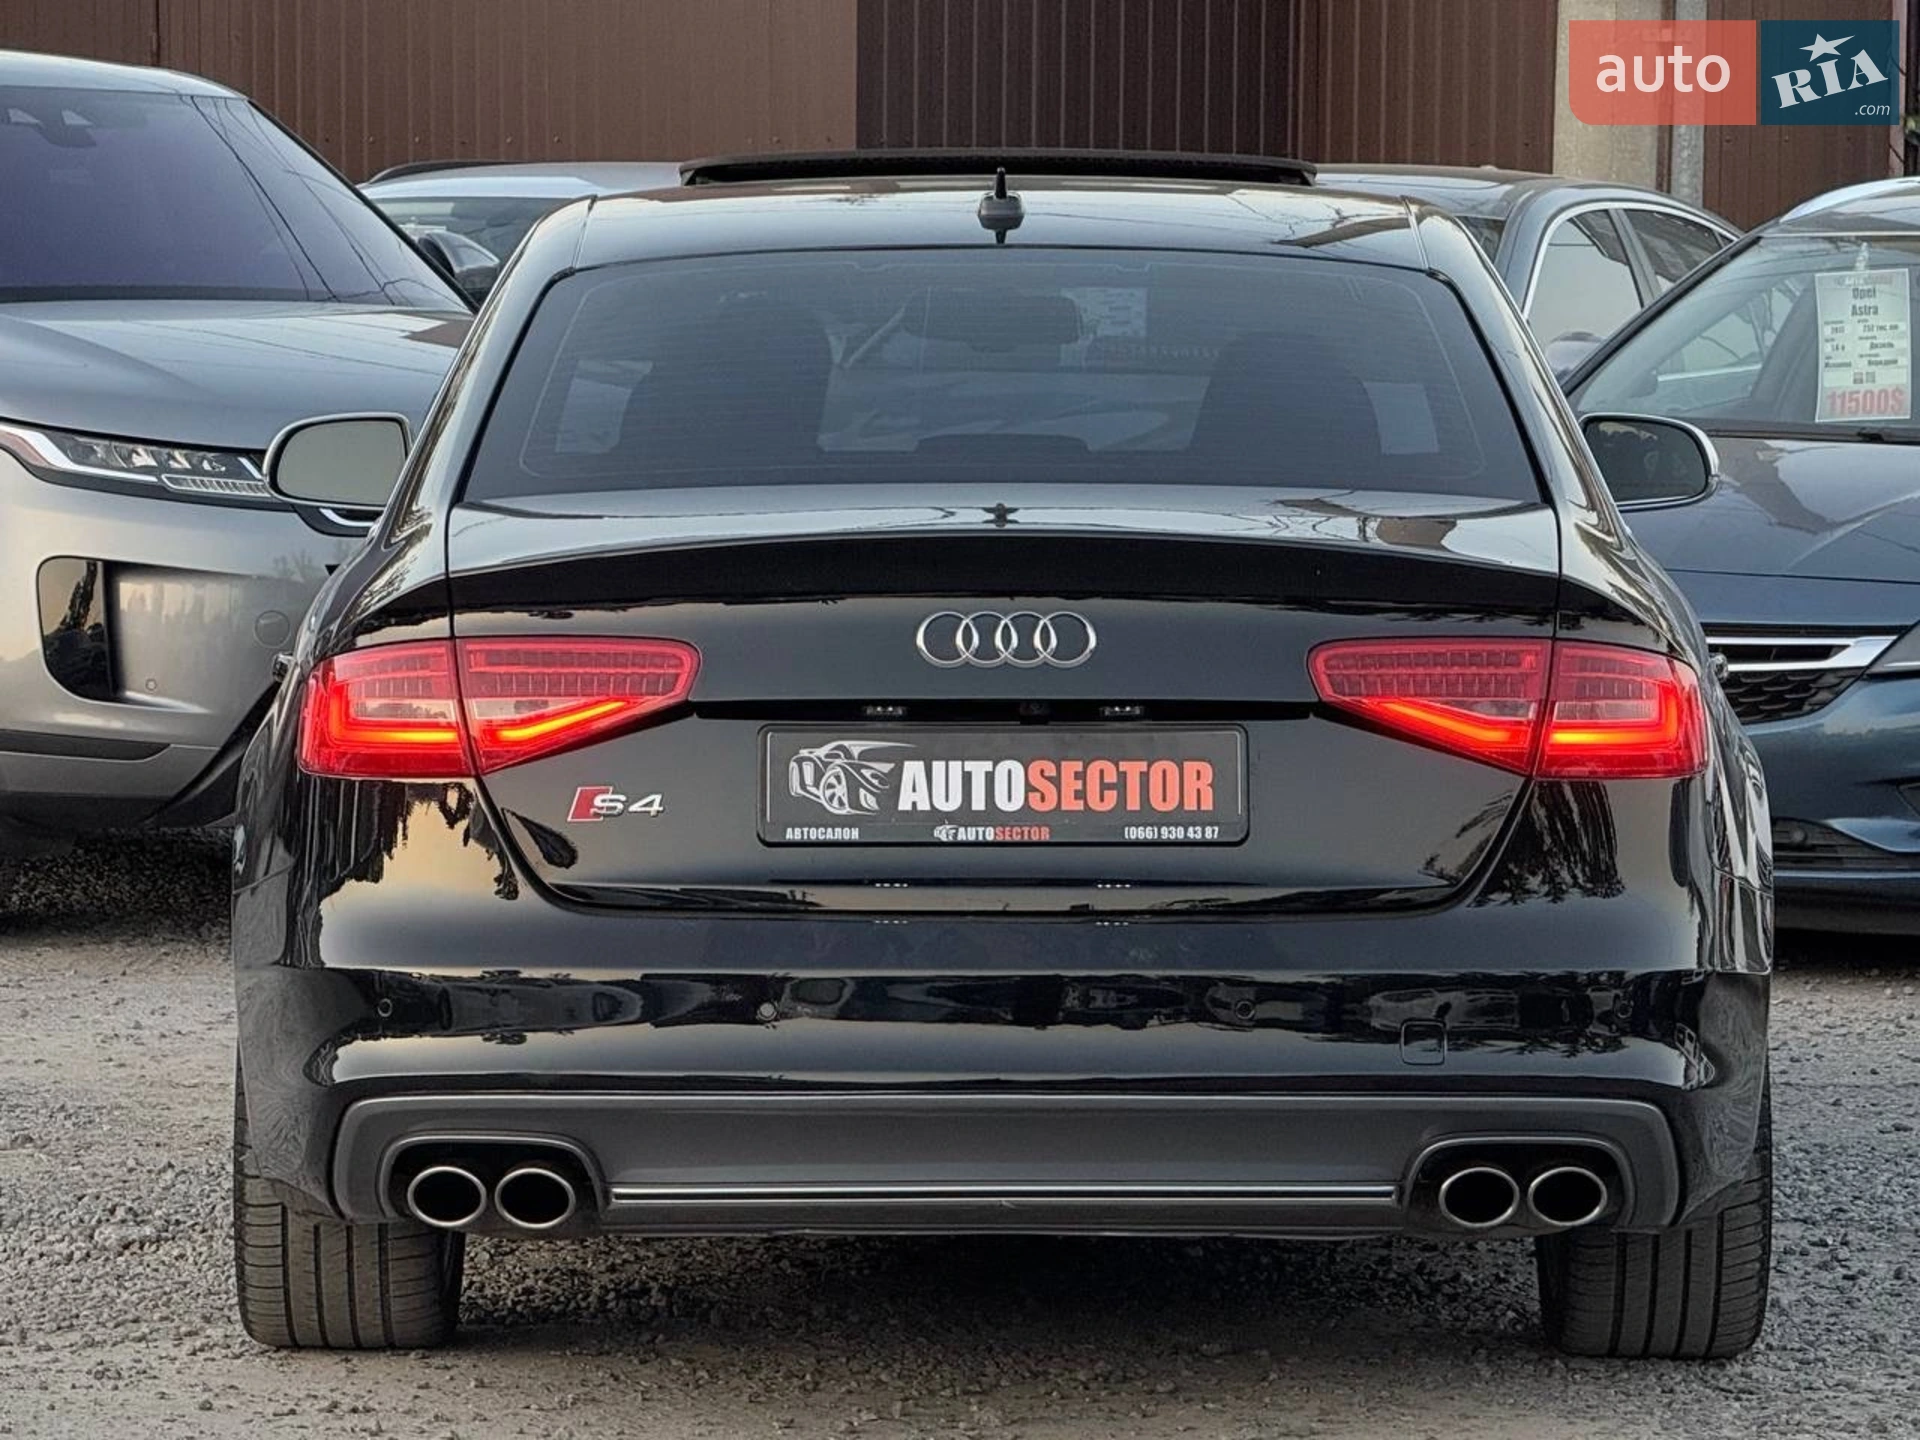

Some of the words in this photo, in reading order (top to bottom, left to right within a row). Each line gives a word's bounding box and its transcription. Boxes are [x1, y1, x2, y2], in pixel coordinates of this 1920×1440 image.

[1851, 304, 1879, 317] Astra
[1827, 386, 1905, 415] 11500$
[897, 759, 1214, 813] AUTOSECTOR
[590, 793, 664, 817] S4
[785, 827, 859, 840] АВТОСАЛОН
[956, 826, 1050, 841] AUTOSECTOR
[1124, 826, 1158, 840] (066)
[1160, 826, 1185, 840] 930
[1186, 826, 1202, 840] 43
[1204, 826, 1219, 840] 87
